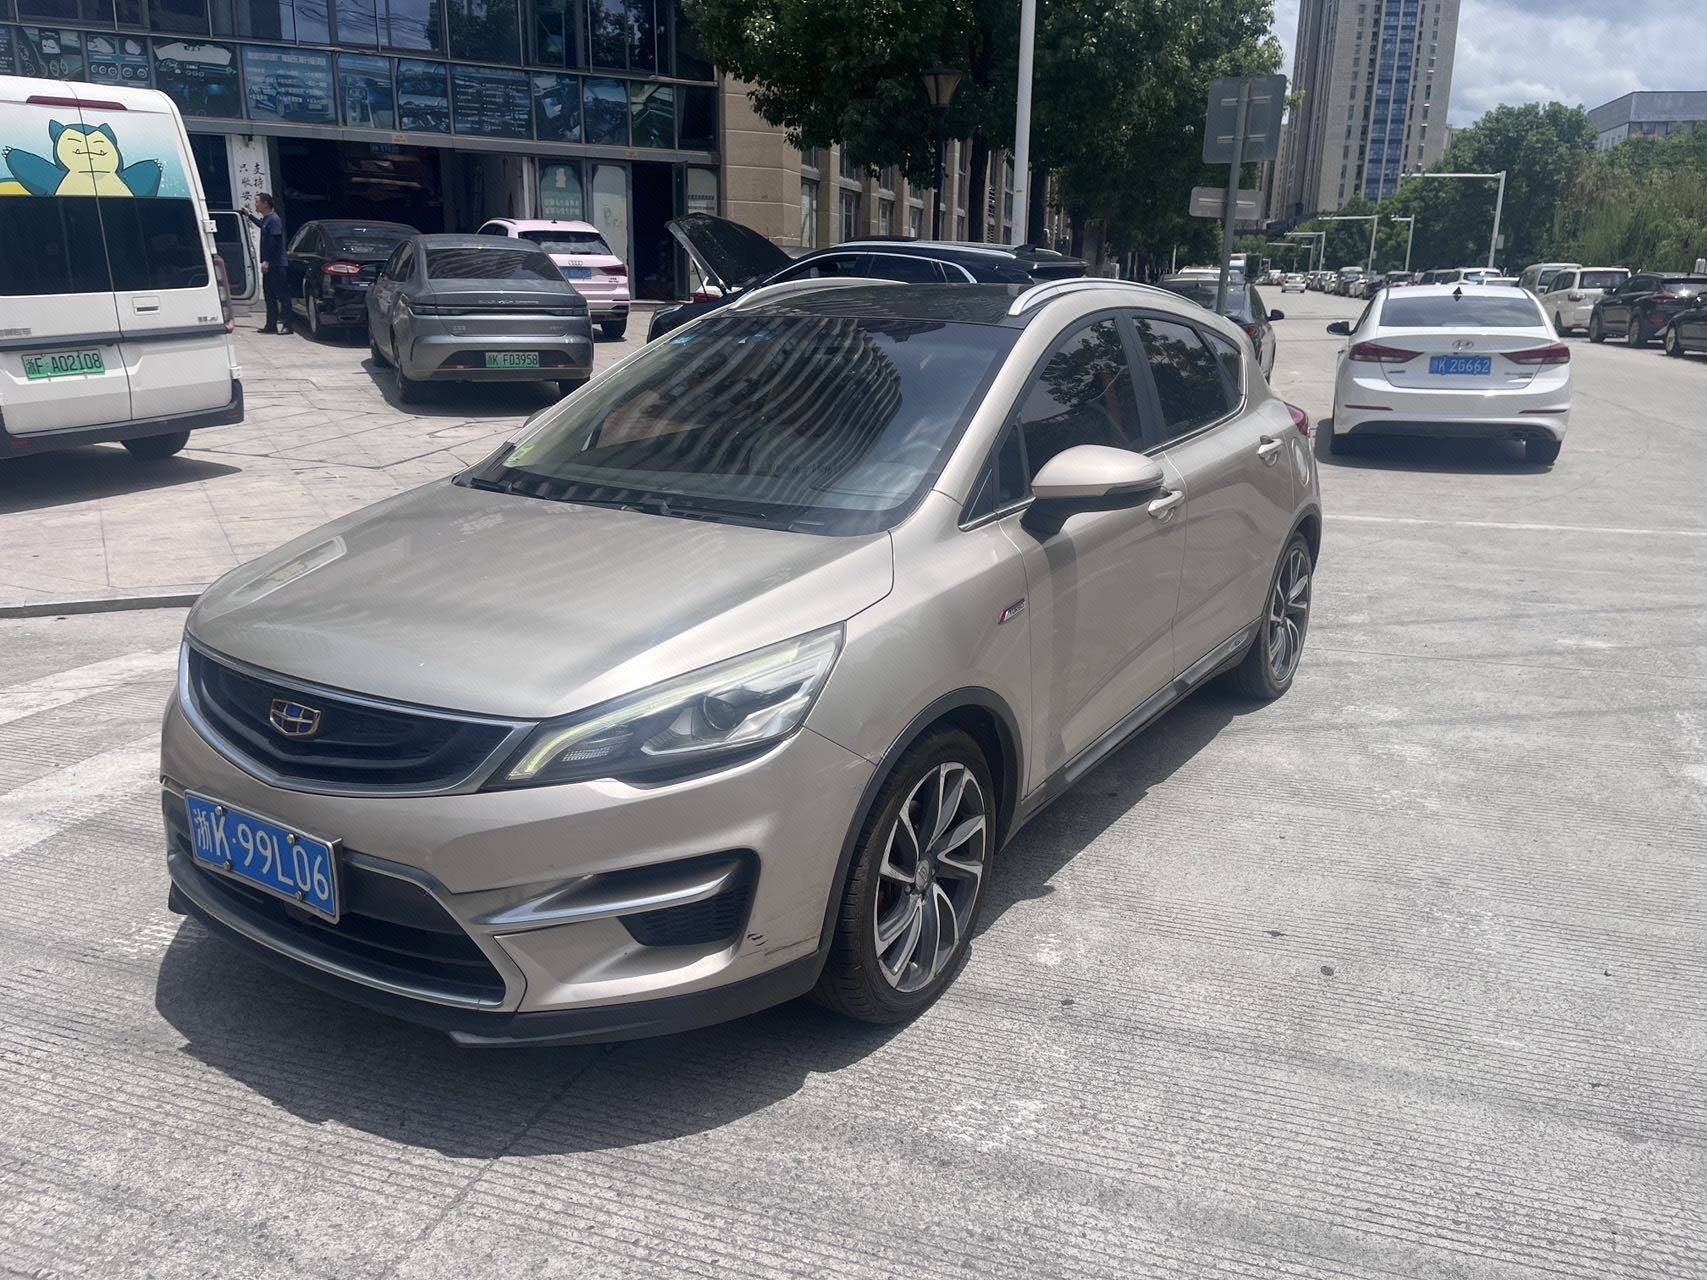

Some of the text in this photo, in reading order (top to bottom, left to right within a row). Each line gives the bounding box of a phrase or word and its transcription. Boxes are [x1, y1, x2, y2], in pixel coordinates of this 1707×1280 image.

[253, 162, 265, 196] 支持
[51, 353, 102, 373] A02108
[503, 354, 538, 366] FD3958
